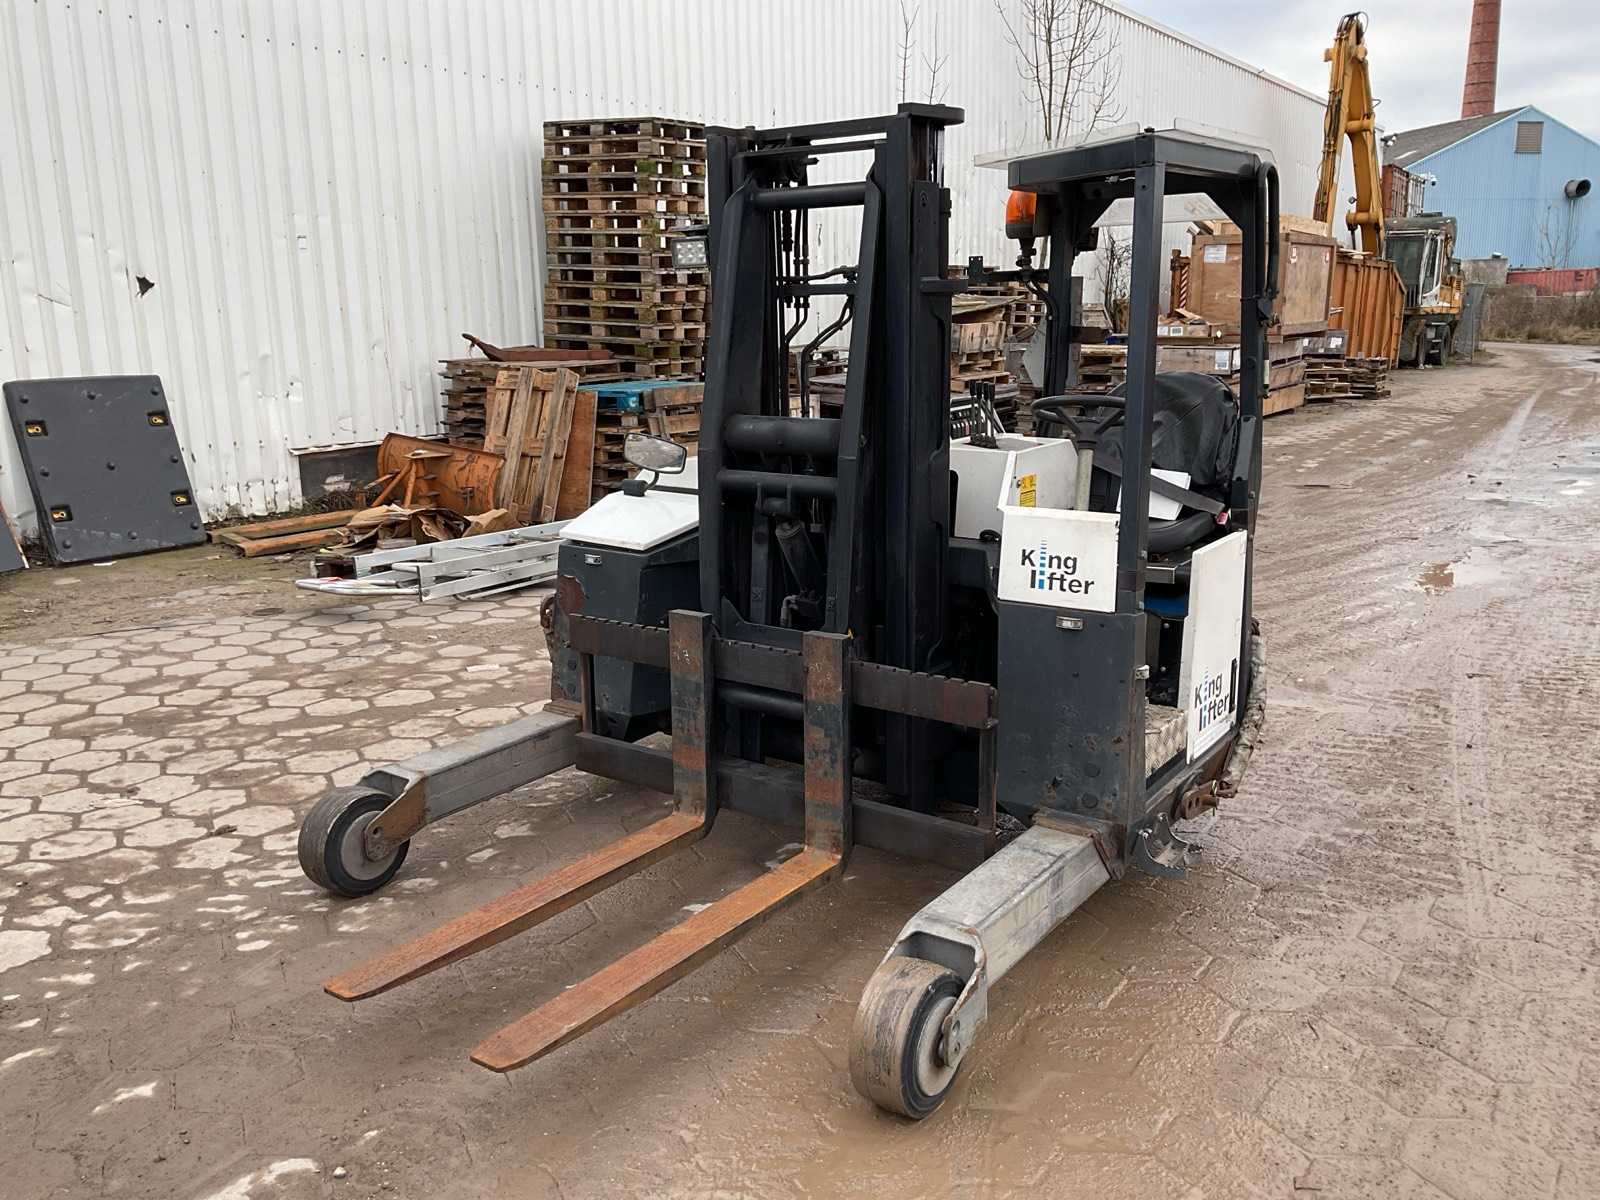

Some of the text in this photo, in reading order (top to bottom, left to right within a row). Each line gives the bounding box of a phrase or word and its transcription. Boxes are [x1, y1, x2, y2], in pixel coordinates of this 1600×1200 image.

[1021, 543, 1077, 575] King
[1030, 569, 1095, 595] lifter
[1194, 669, 1223, 709] King
[1199, 693, 1230, 732] lifter
